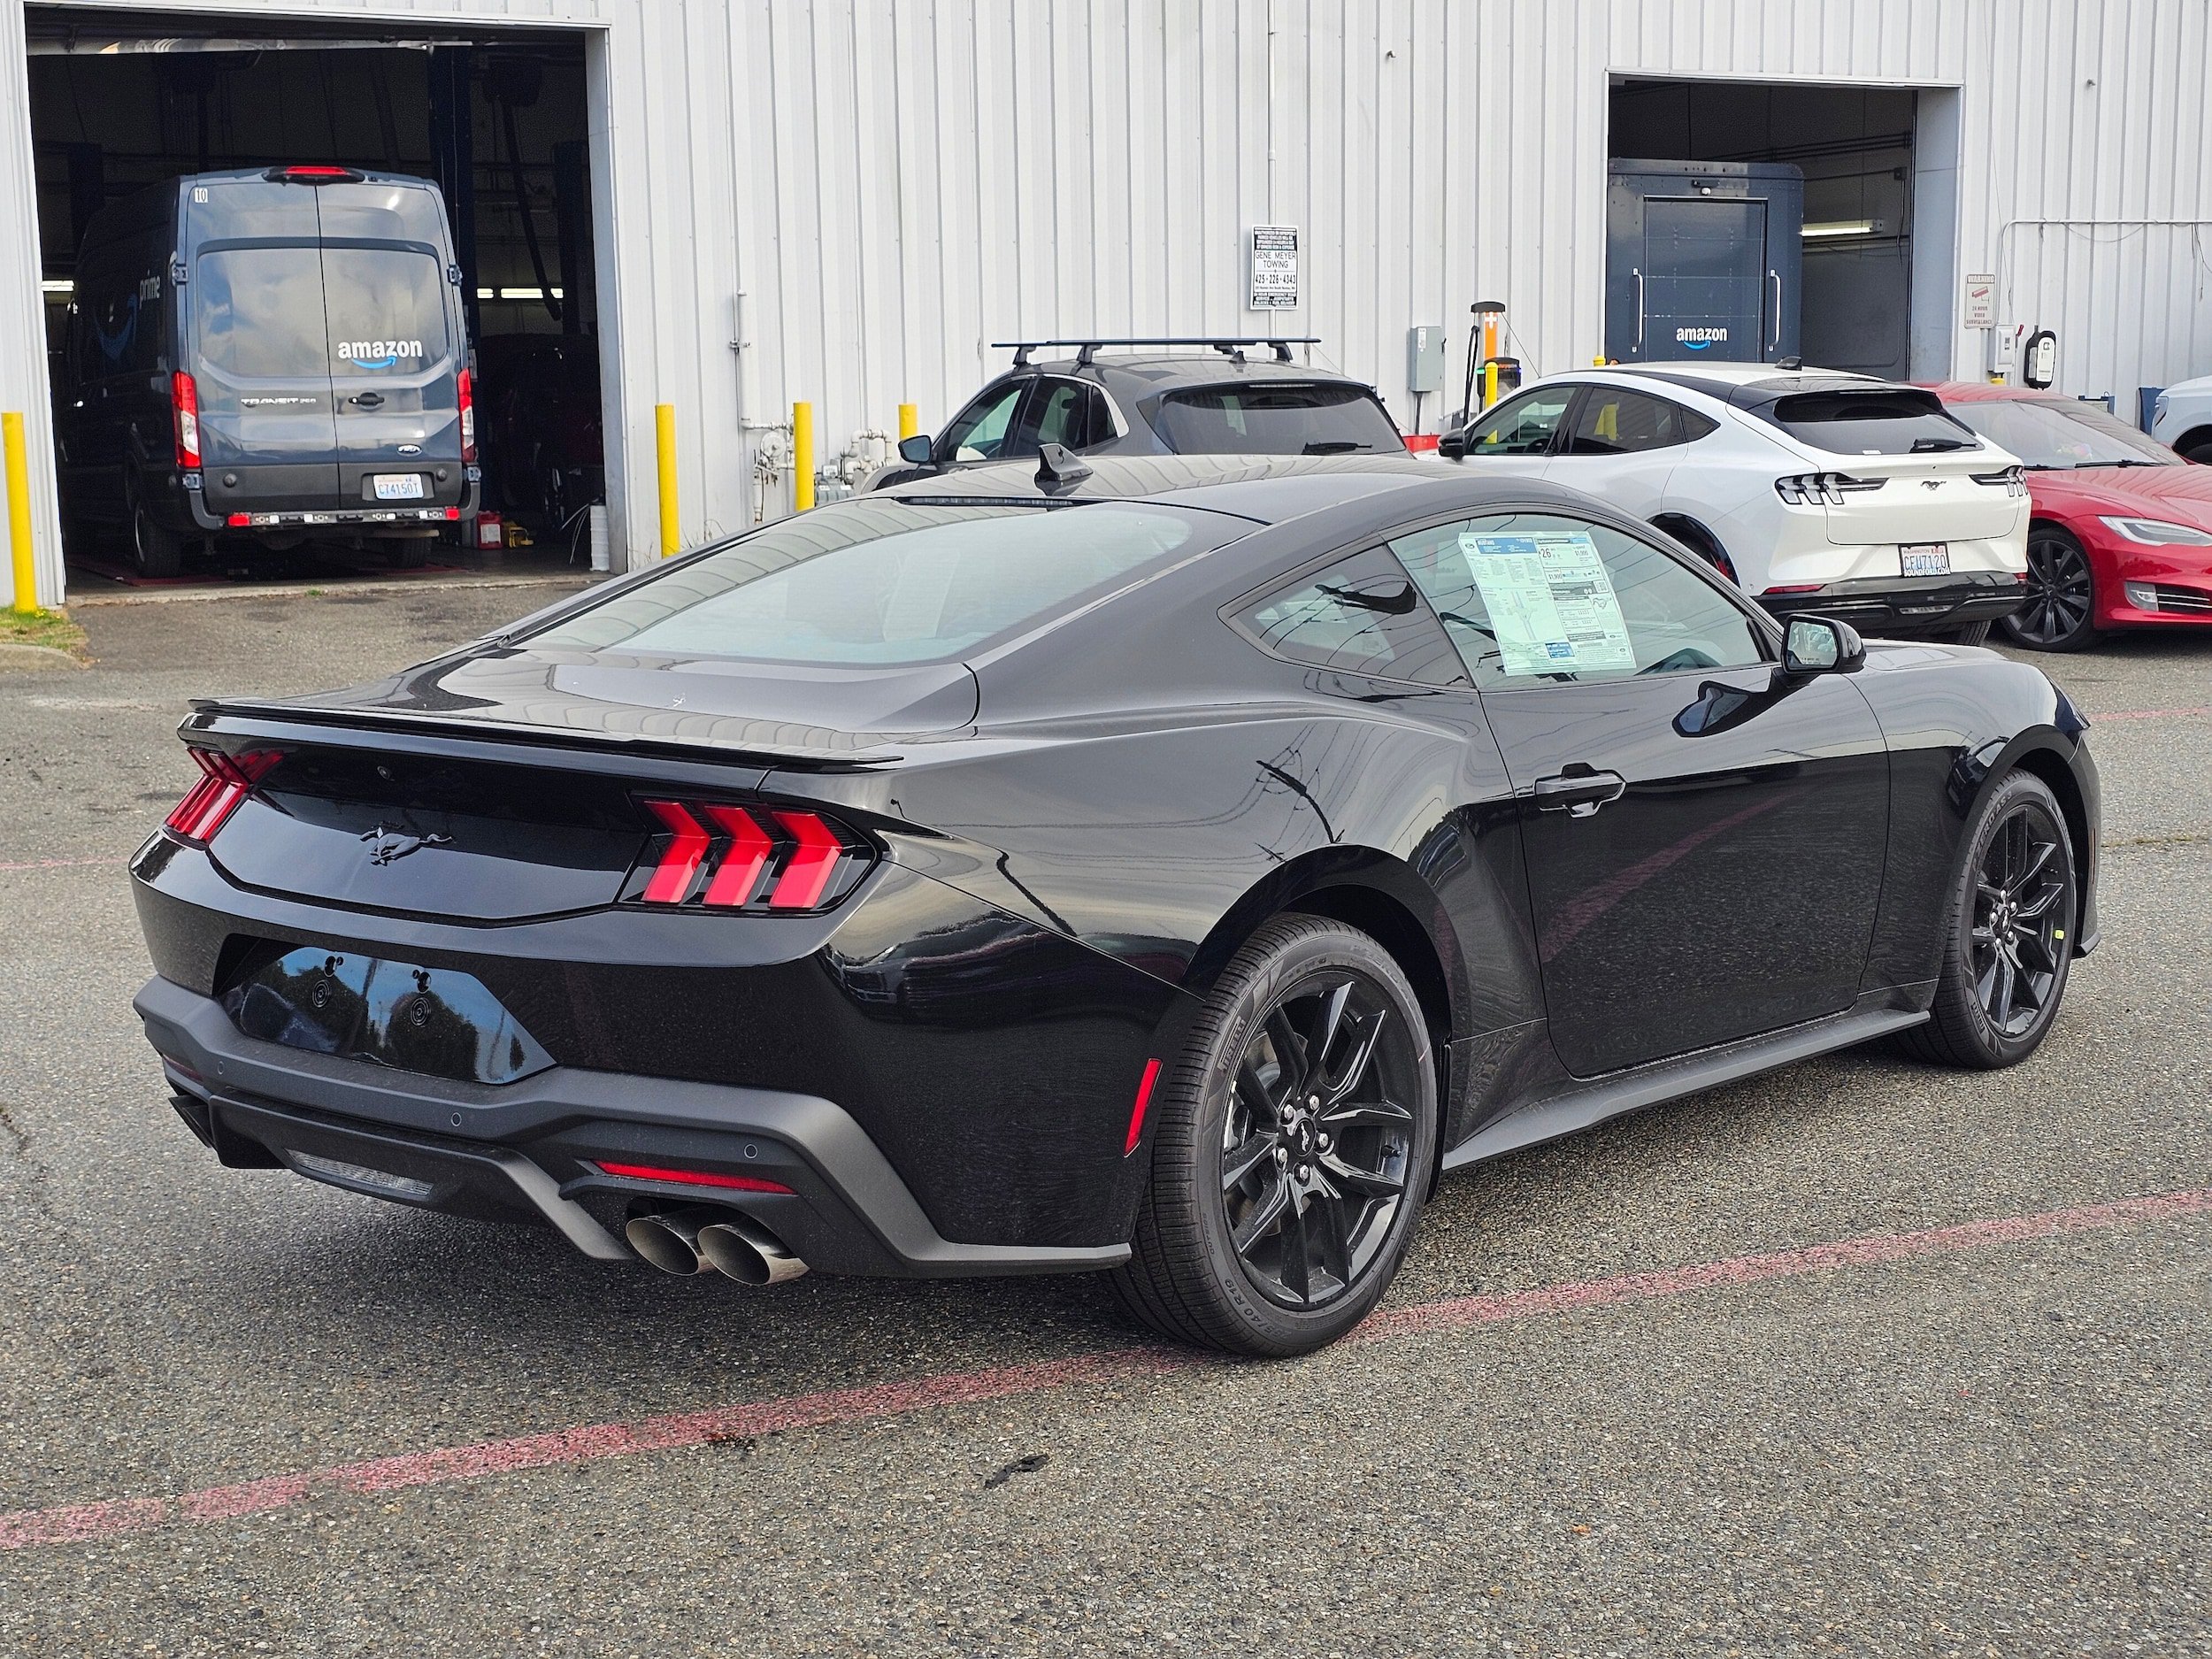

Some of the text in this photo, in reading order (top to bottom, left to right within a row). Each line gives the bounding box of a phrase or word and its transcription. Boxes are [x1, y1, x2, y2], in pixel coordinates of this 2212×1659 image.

[196, 189, 206, 203] 10
[1255, 250, 1296, 260] GENE MEYER
[1263, 259, 1288, 268] TOWING
[139, 269, 160, 310] prime
[1676, 327, 1727, 342] amazon
[337, 340, 423, 359] amazon
[378, 482, 419, 495] C74150T
[1540, 548, 1552, 558] 26
[1904, 555, 1947, 571] CFU7120
[1995, 795, 2007, 815] AS
[1216, 1015, 1248, 1071] PIRELLI
